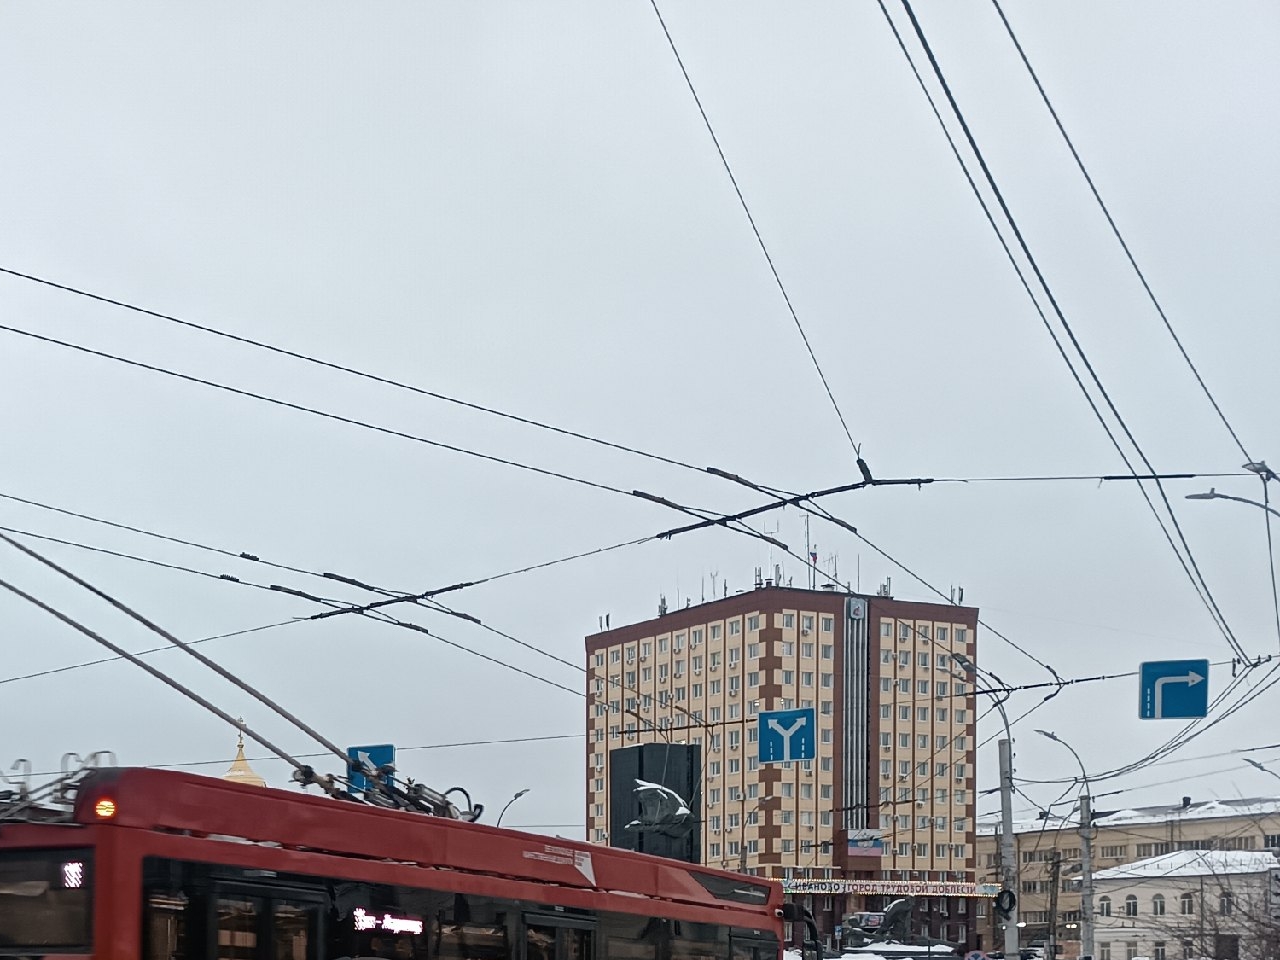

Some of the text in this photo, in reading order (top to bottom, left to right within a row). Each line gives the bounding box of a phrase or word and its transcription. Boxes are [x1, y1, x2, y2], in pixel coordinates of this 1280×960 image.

[847, 883, 877, 893] ГОРОД
[880, 883, 929, 894] ТРУДОВОЙ
[931, 884, 976, 895] ДОБЛЕСТИ
